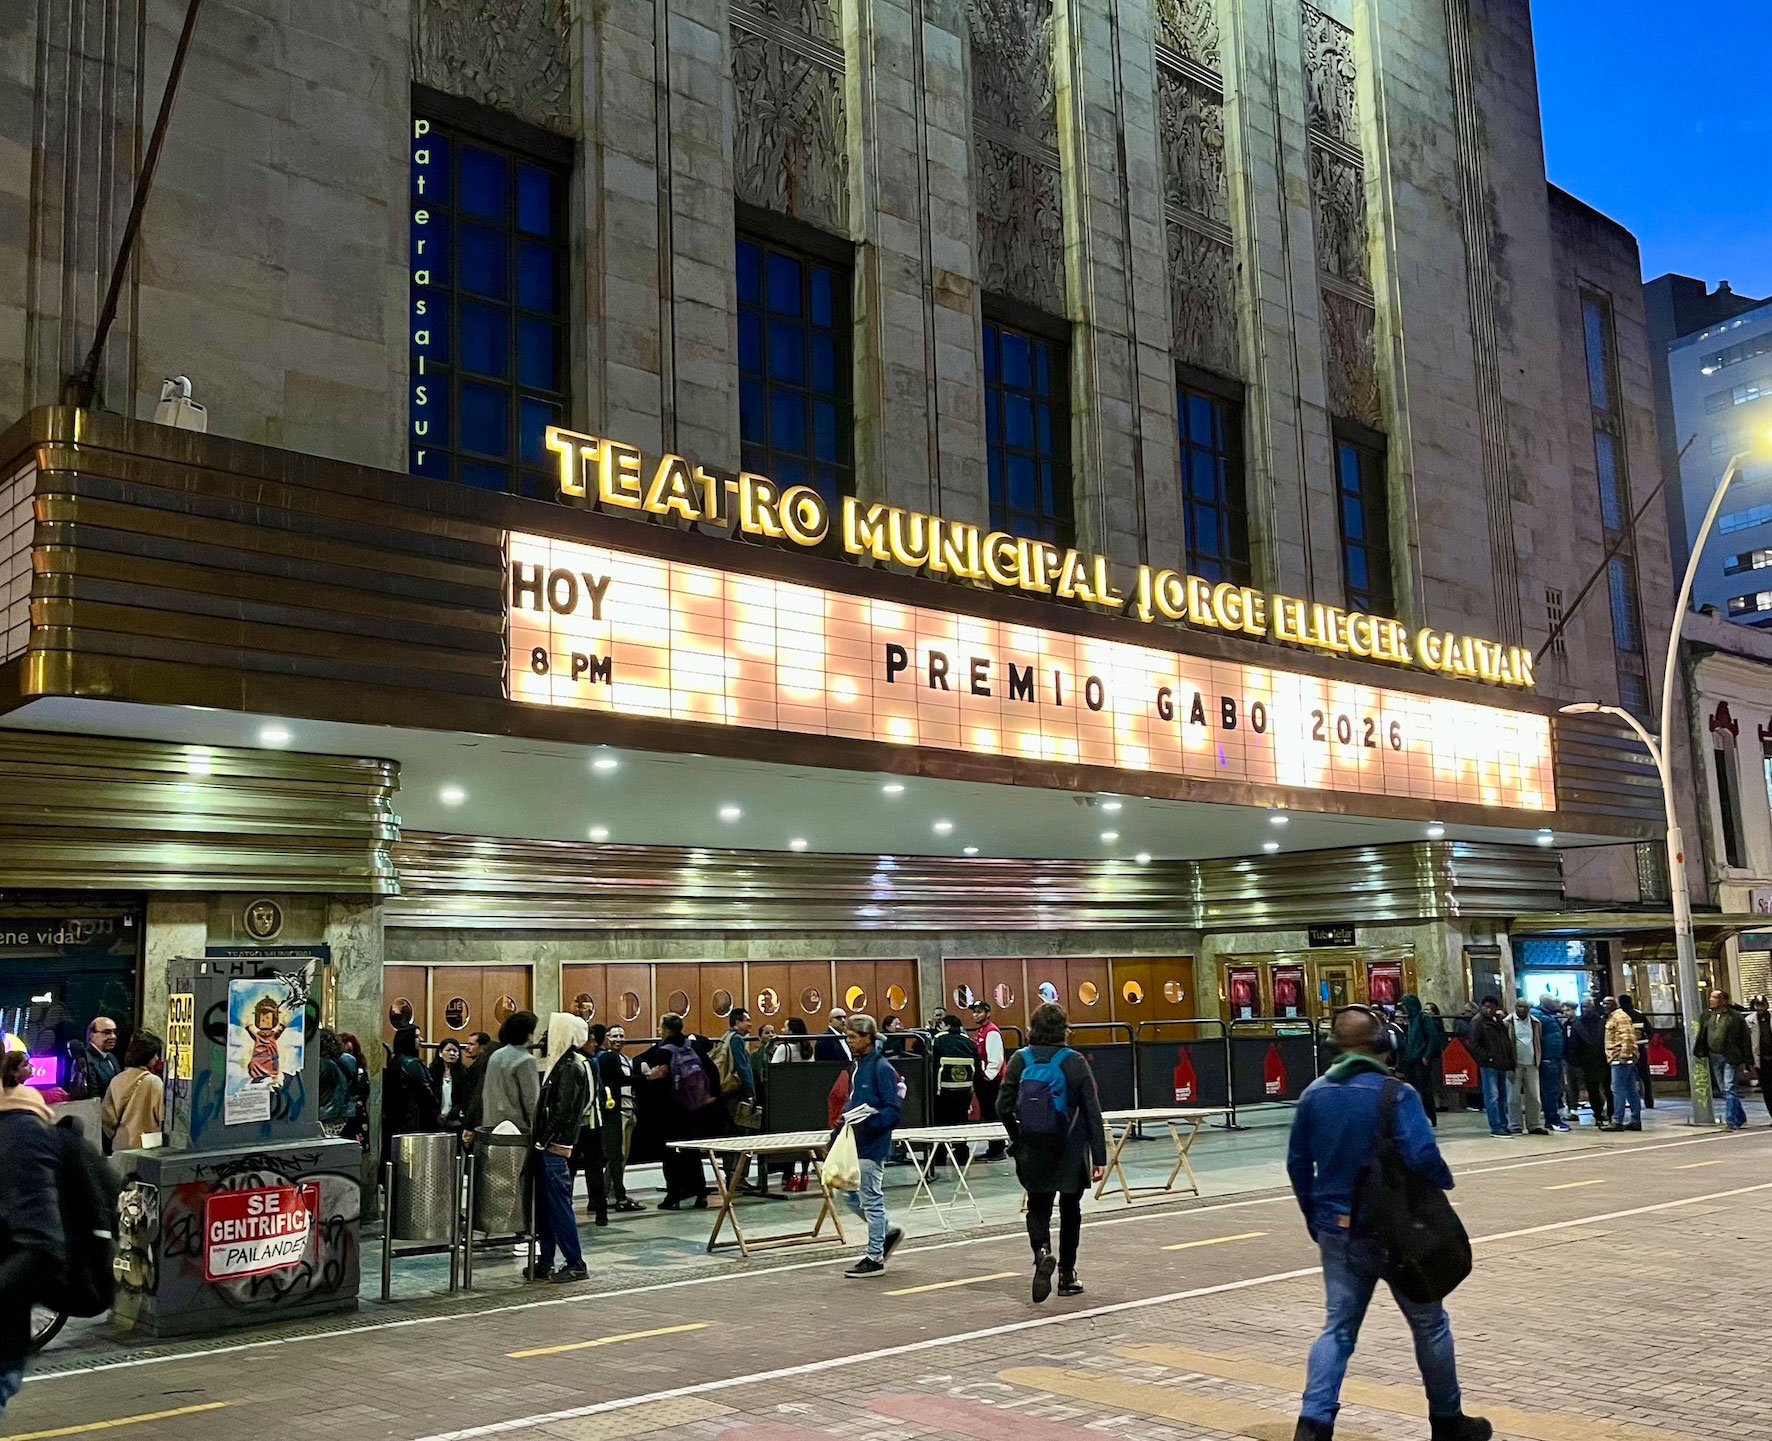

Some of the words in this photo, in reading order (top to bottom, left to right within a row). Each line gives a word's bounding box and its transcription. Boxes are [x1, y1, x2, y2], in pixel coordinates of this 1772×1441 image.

[545, 425, 830, 547] TEATRO
[843, 495, 1124, 607] MUNICIPAL
[1137, 563, 1267, 637] JORGE
[1272, 593, 1413, 664] ELIECER
[1416, 626, 1536, 688] GAITAN
[511, 559, 611, 621] HOY
[531, 646, 549, 675] 8
[571, 651, 612, 685] PM
[885, 642, 1105, 712] PREMIO
[1156, 686, 1268, 734] GABO
[1311, 708, 1402, 751] 2026
[246, 1192, 281, 1216] SE
